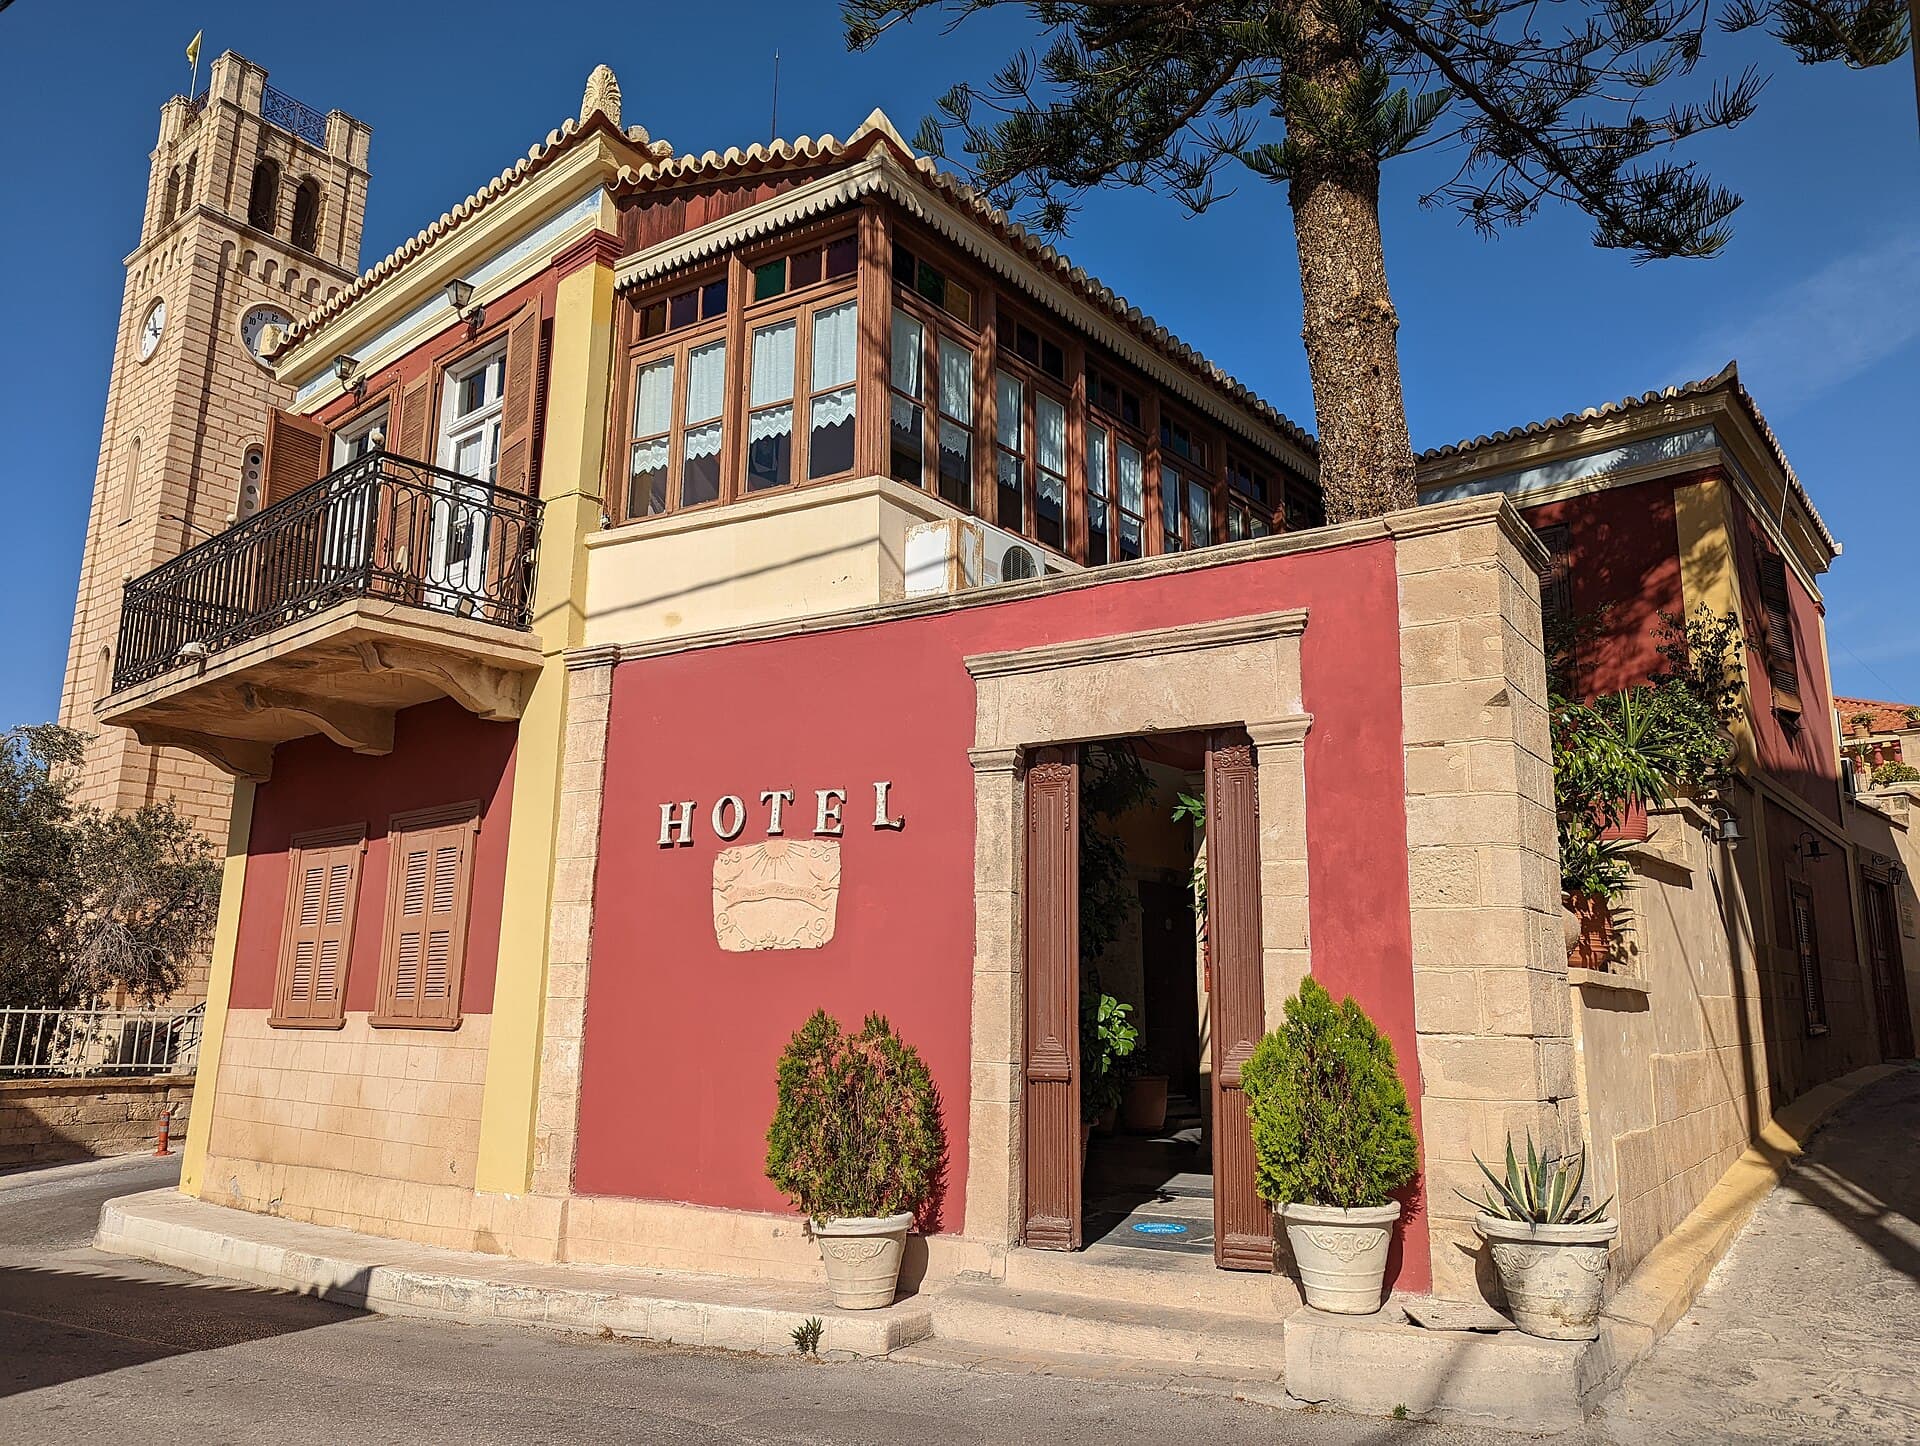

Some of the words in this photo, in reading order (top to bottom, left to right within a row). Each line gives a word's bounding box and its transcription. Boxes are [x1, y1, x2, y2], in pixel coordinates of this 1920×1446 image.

[249, 317, 256, 325] 10
[271, 313, 278, 322] 12
[243, 326, 248, 334] 9
[246, 337, 251, 345] 8
[657, 781, 905, 846] HOTEL
